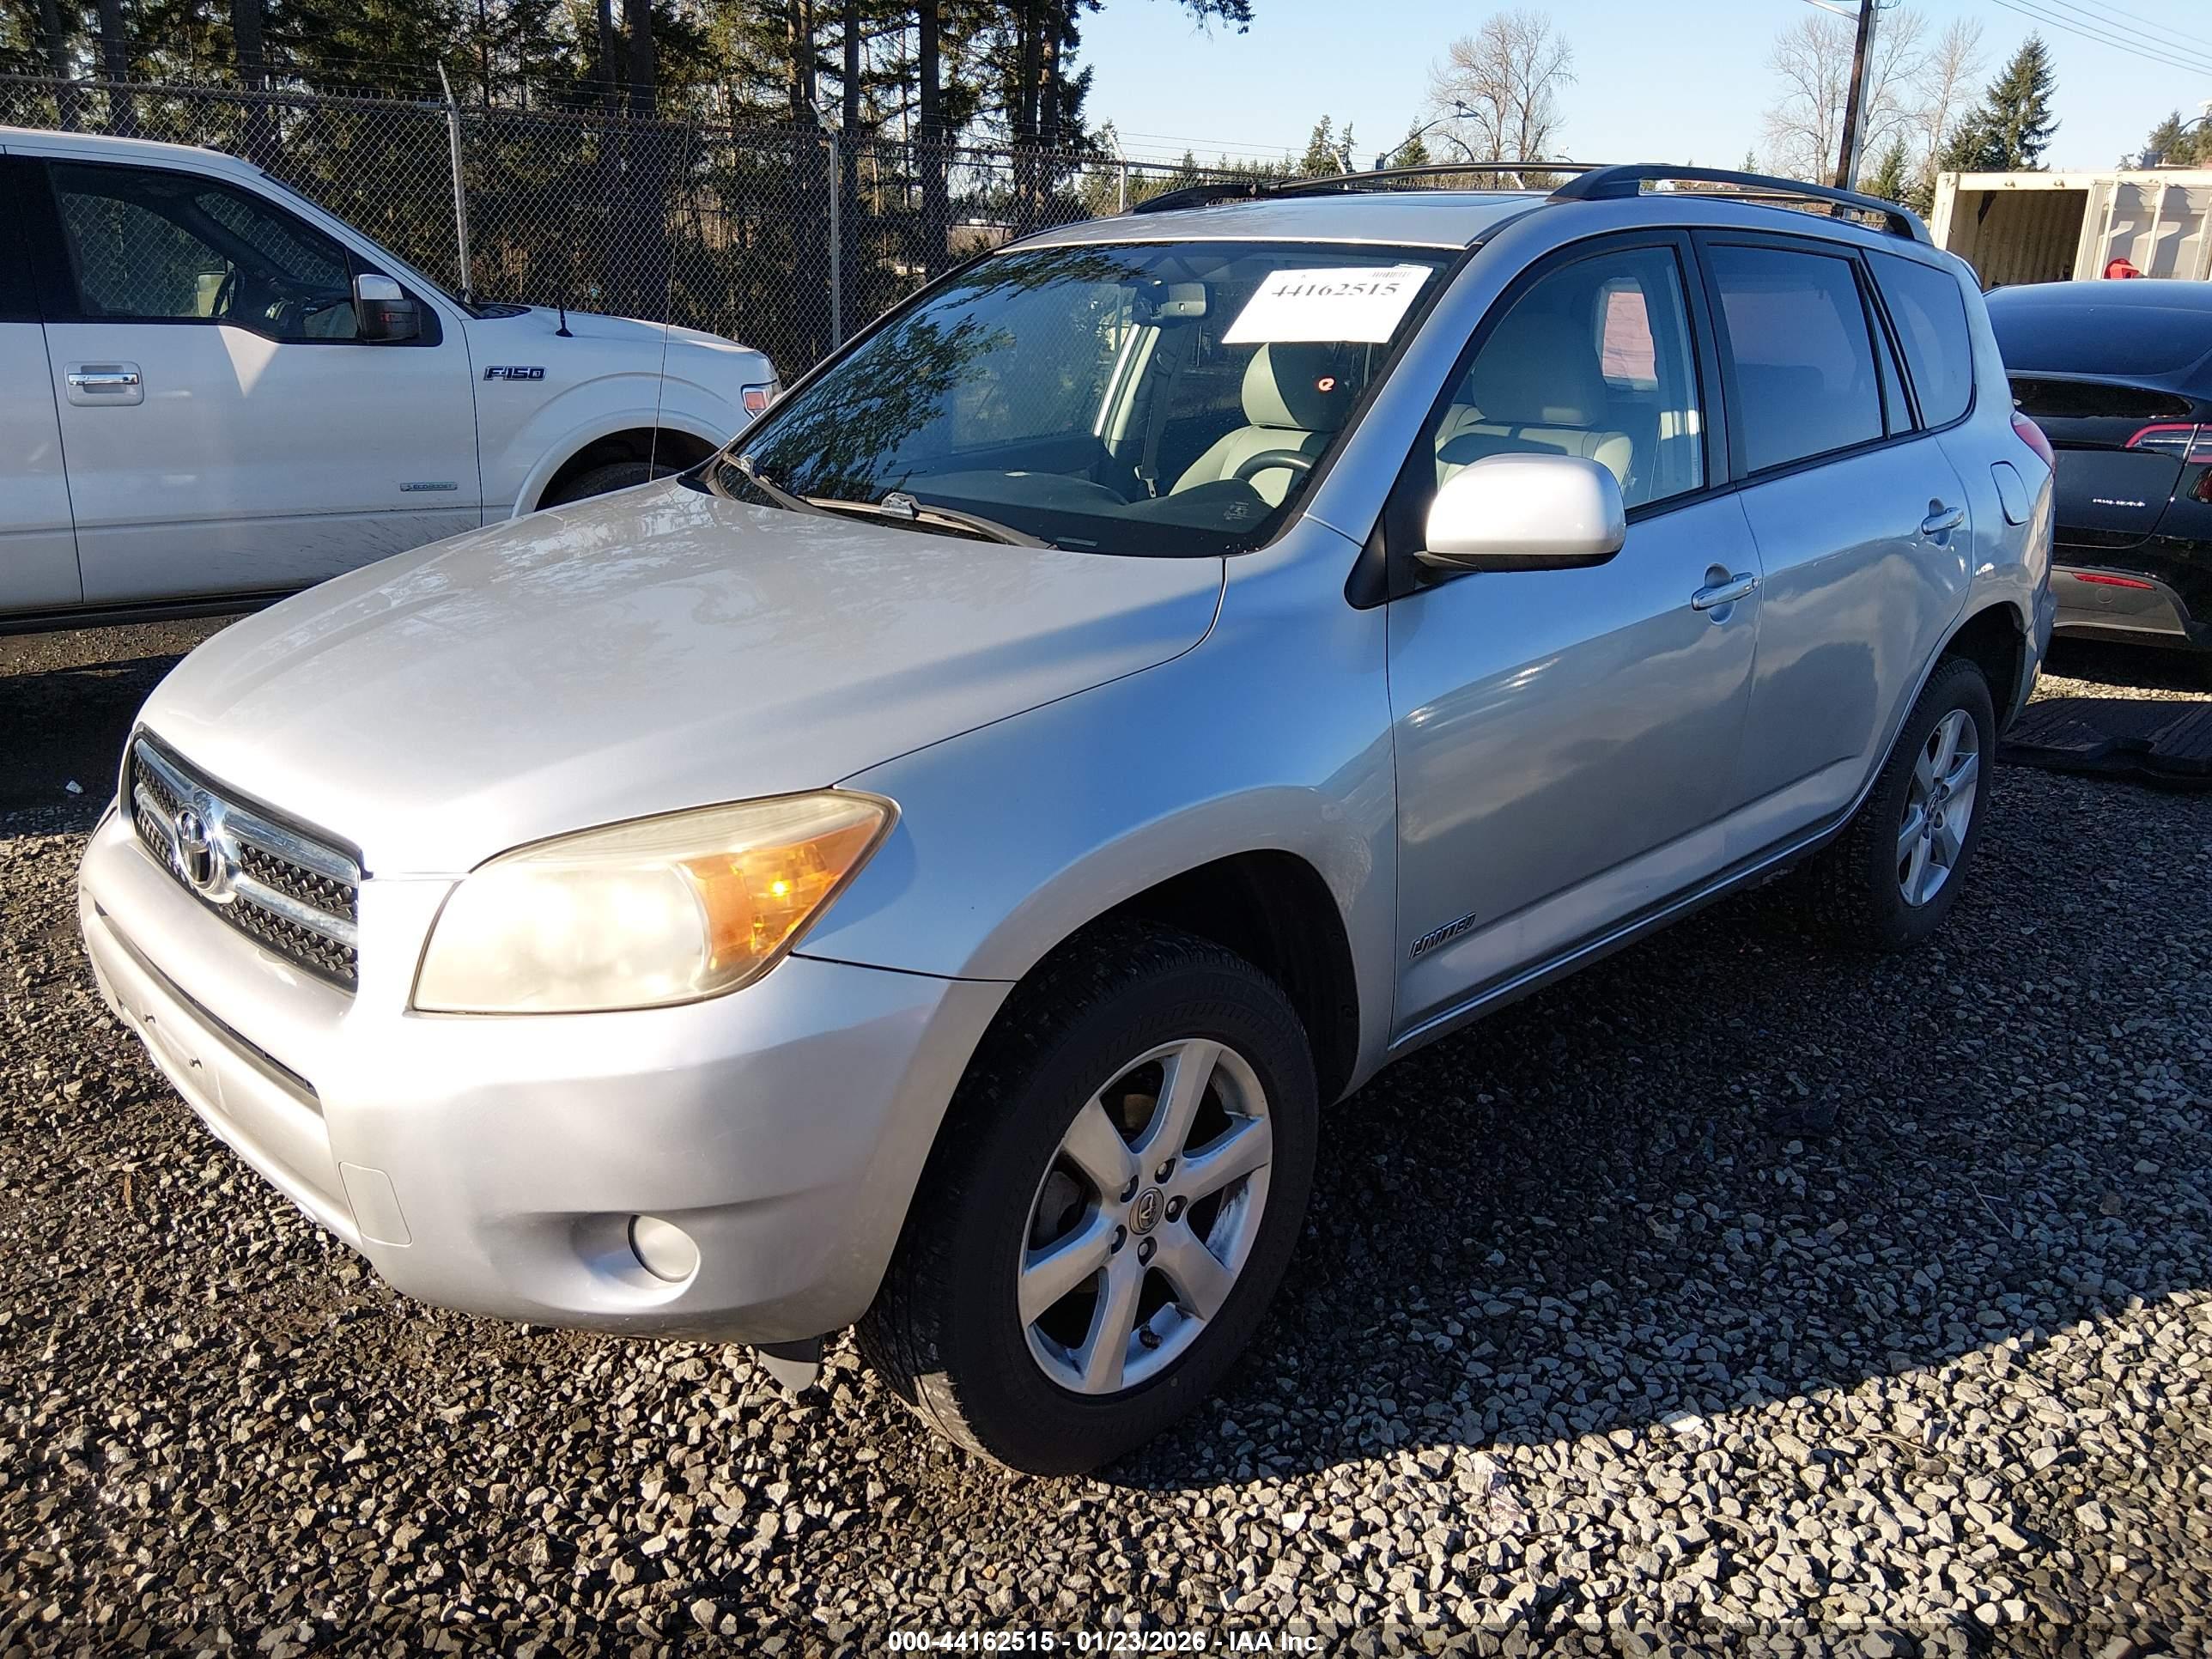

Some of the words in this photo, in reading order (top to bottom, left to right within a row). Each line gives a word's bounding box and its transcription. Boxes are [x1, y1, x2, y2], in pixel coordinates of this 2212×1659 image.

[1271, 283, 1401, 297] 44162515
[483, 366, 547, 380] F-150
[1409, 912, 1477, 959] LIMITED
